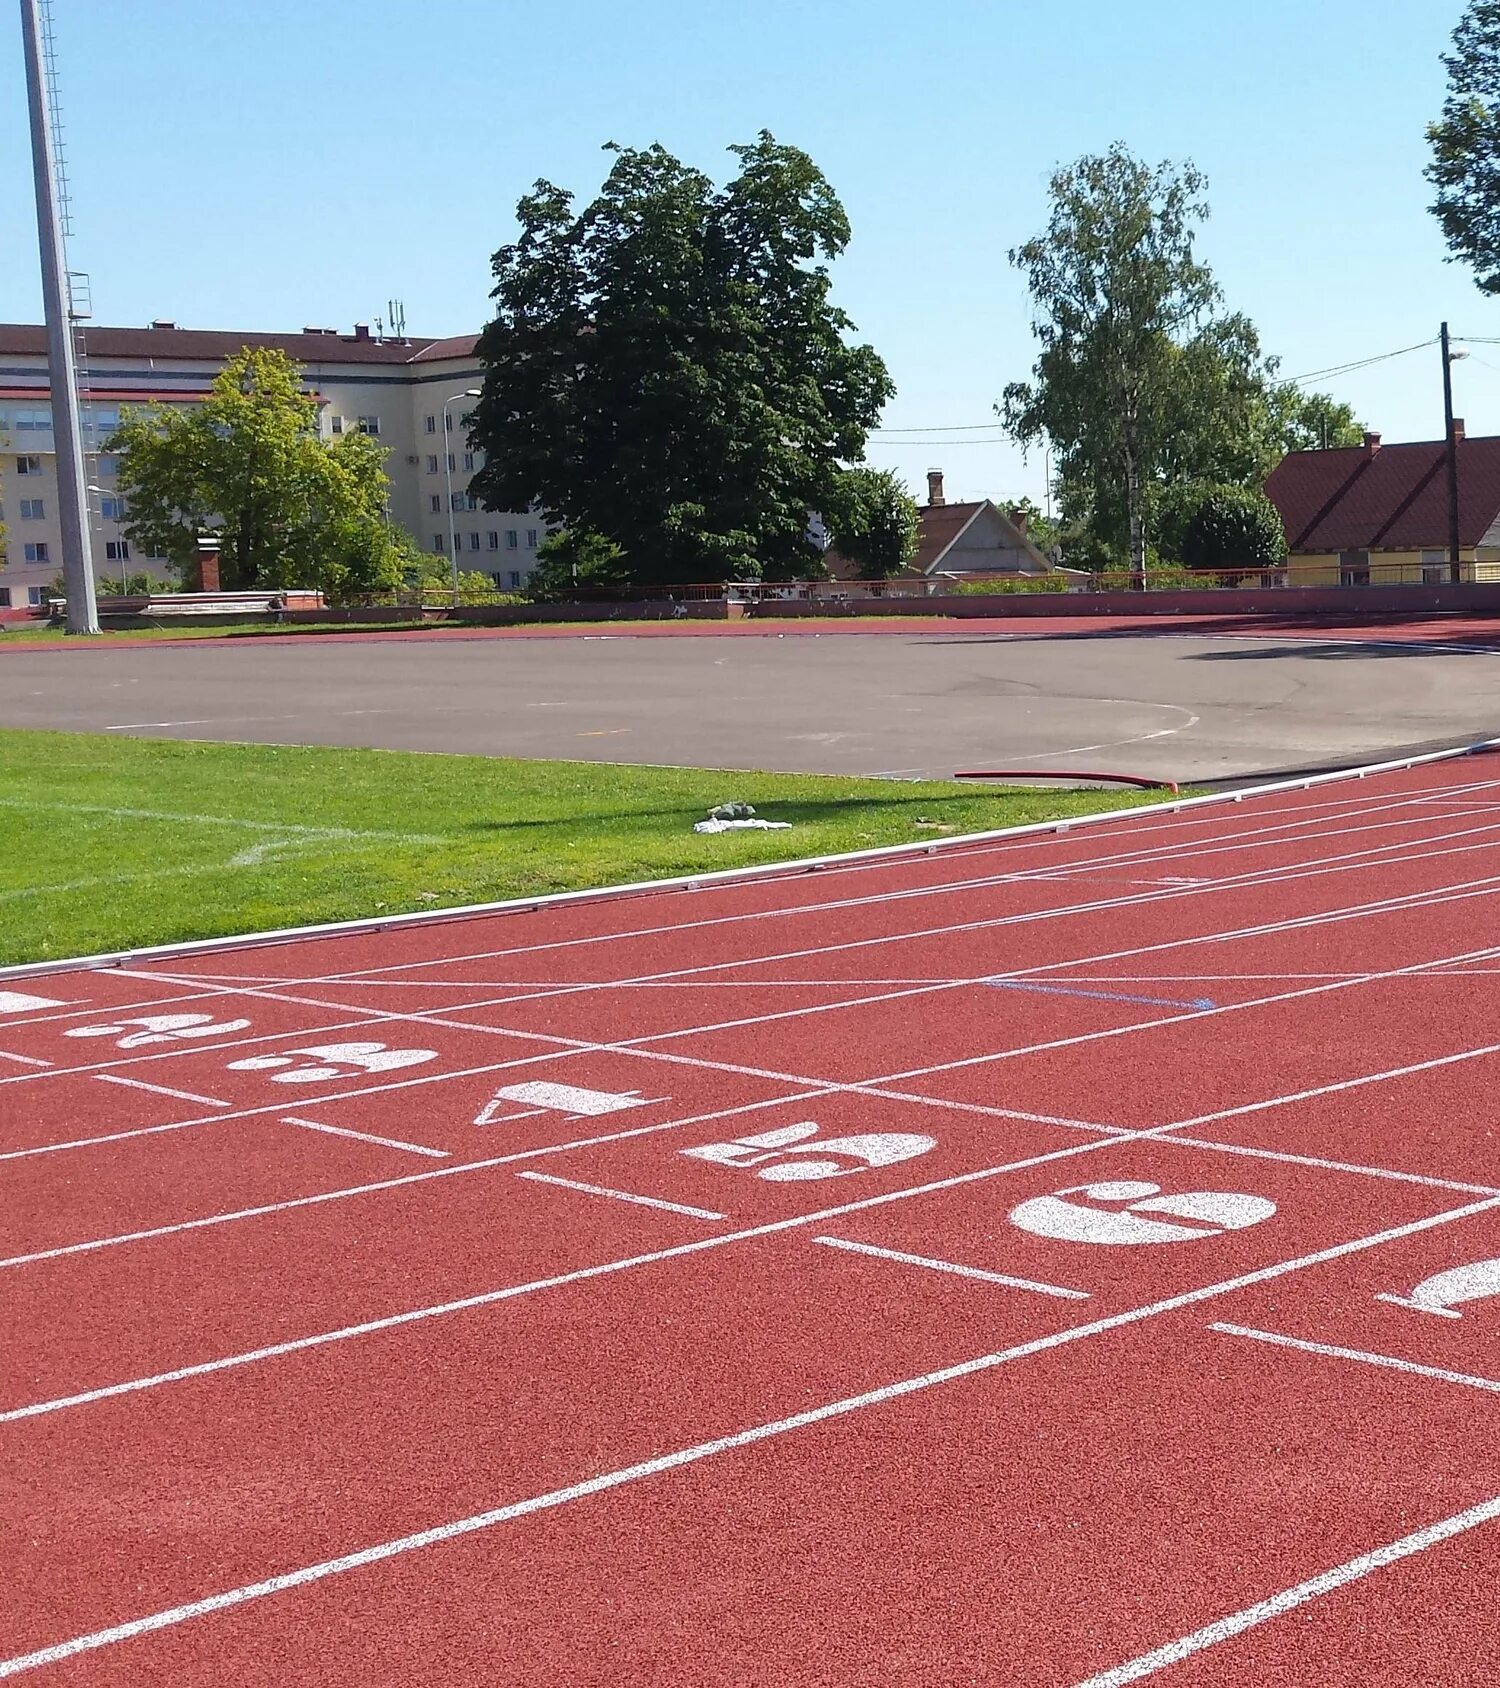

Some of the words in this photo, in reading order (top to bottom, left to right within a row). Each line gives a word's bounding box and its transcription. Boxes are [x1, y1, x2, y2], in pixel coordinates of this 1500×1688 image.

[63, 1013, 251, 1049] 2
[226, 1042, 439, 1084] 3
[473, 1080, 673, 1126] 4
[679, 1121, 938, 1182] 5
[1008, 1180, 1278, 1245] 6
